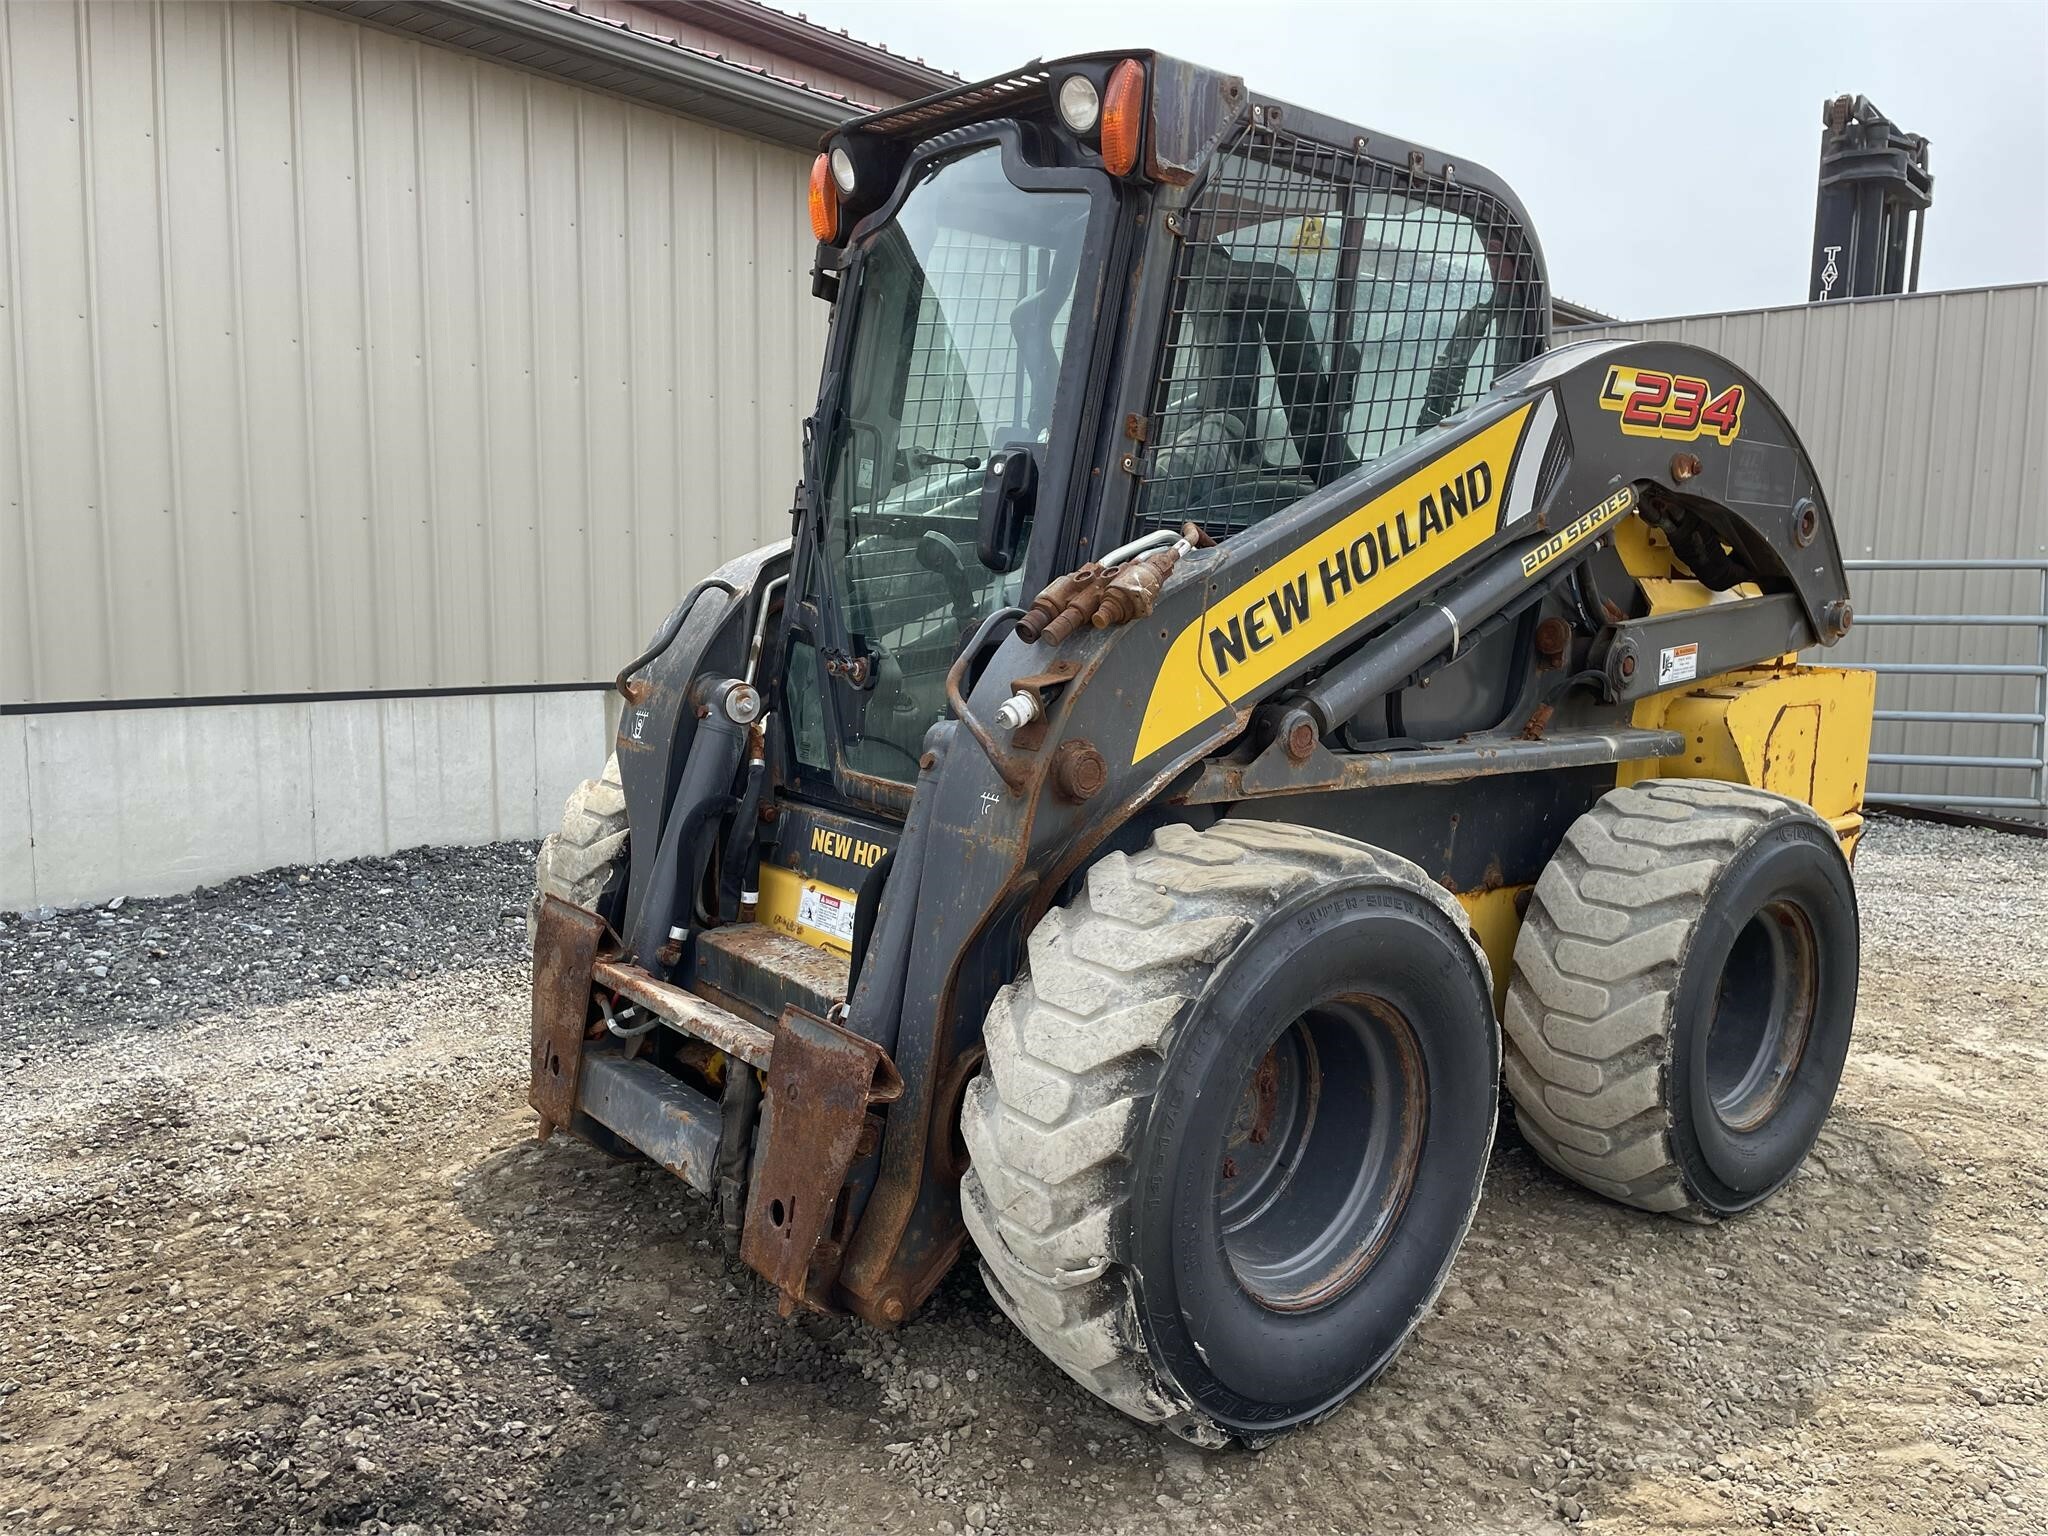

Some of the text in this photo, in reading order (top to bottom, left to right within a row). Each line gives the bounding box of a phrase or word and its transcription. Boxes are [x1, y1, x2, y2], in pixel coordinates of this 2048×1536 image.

[1600, 367, 1744, 443] L234
[1208, 460, 1494, 677] NEW HOLLAND
[1522, 491, 1631, 573] 200 SERIES
[811, 827, 888, 869] NEW HO
